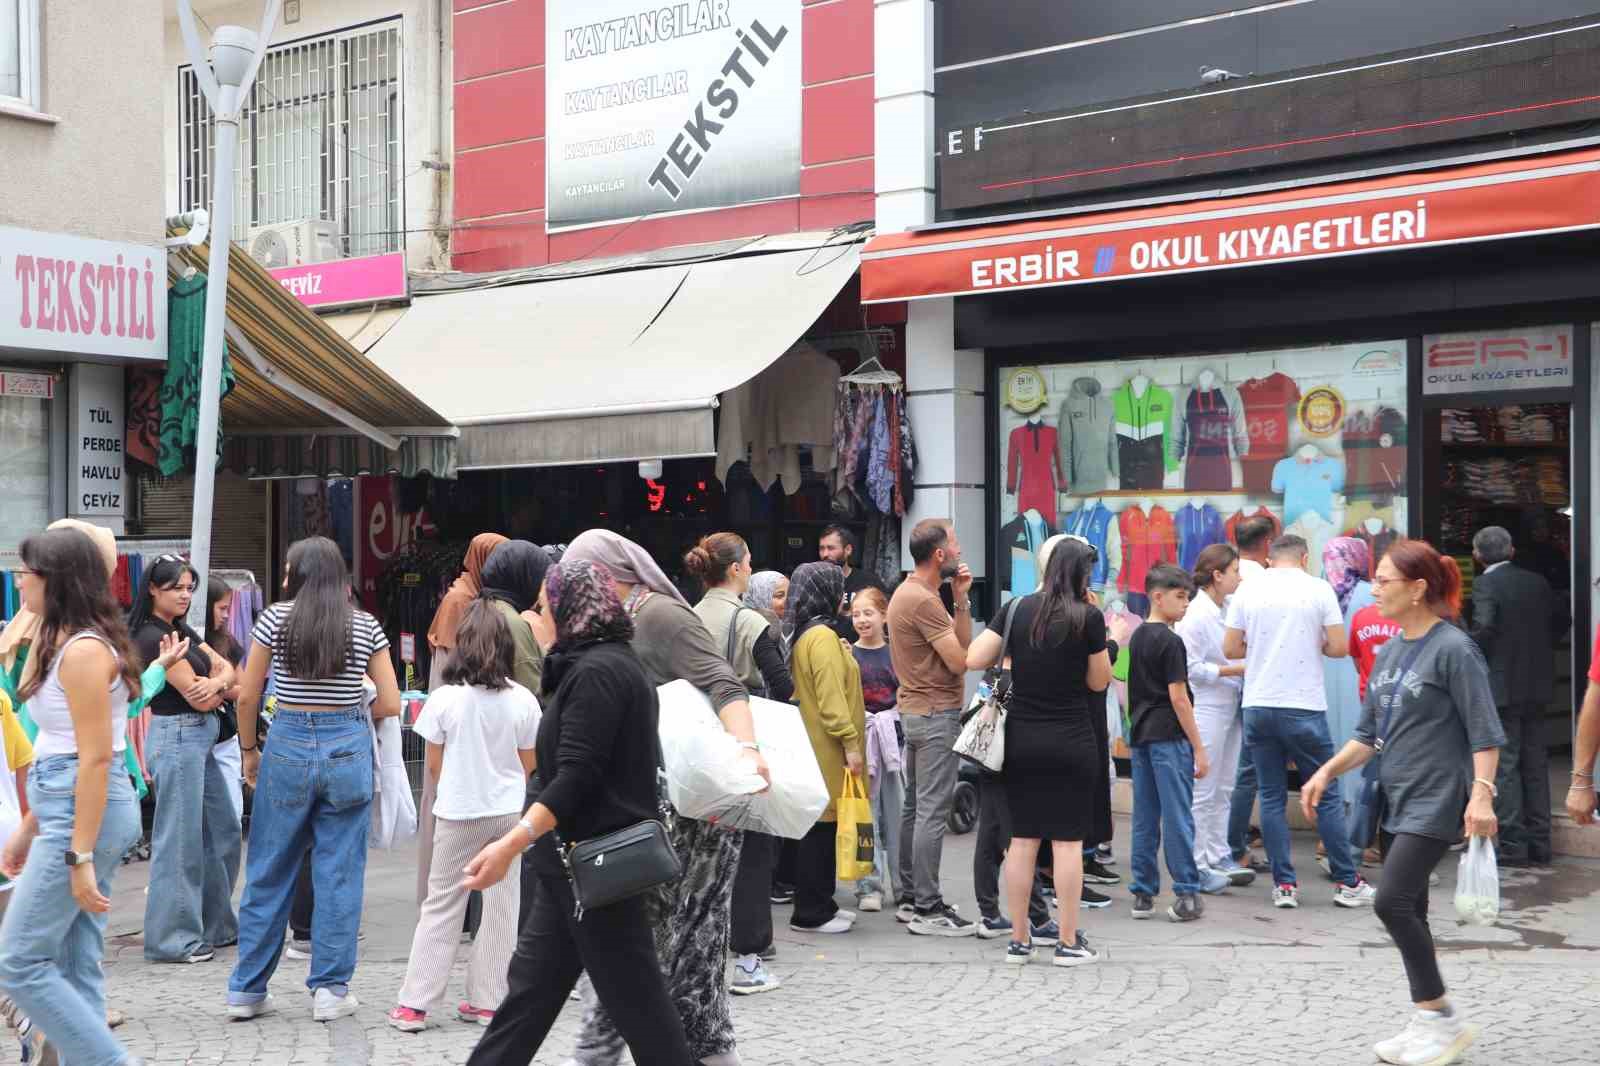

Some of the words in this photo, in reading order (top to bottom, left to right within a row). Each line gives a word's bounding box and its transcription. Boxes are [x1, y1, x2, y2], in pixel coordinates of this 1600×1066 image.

[565, 0, 732, 61] KAYTANCILAR
[565, 70, 689, 115] KAYTANCILAR
[648, 19, 789, 200] TEKSTİL
[565, 130, 656, 160] KAYTANCILAR
[566, 179, 625, 197] KAYTANCILAR
[971, 246, 1080, 287] ERBİR
[1130, 235, 1209, 270] OKUL
[1219, 200, 1427, 261] KIYAFETLERİ
[15, 254, 156, 341] TEKSTİLİ
[1427, 334, 1569, 368] ER-1
[1427, 374, 1467, 384] OKUL
[89, 408, 113, 424] TÜL
[83, 437, 121, 452] PERDE
[82, 465, 121, 480] HAVLU
[82, 491, 120, 510] ÇEYİZ
